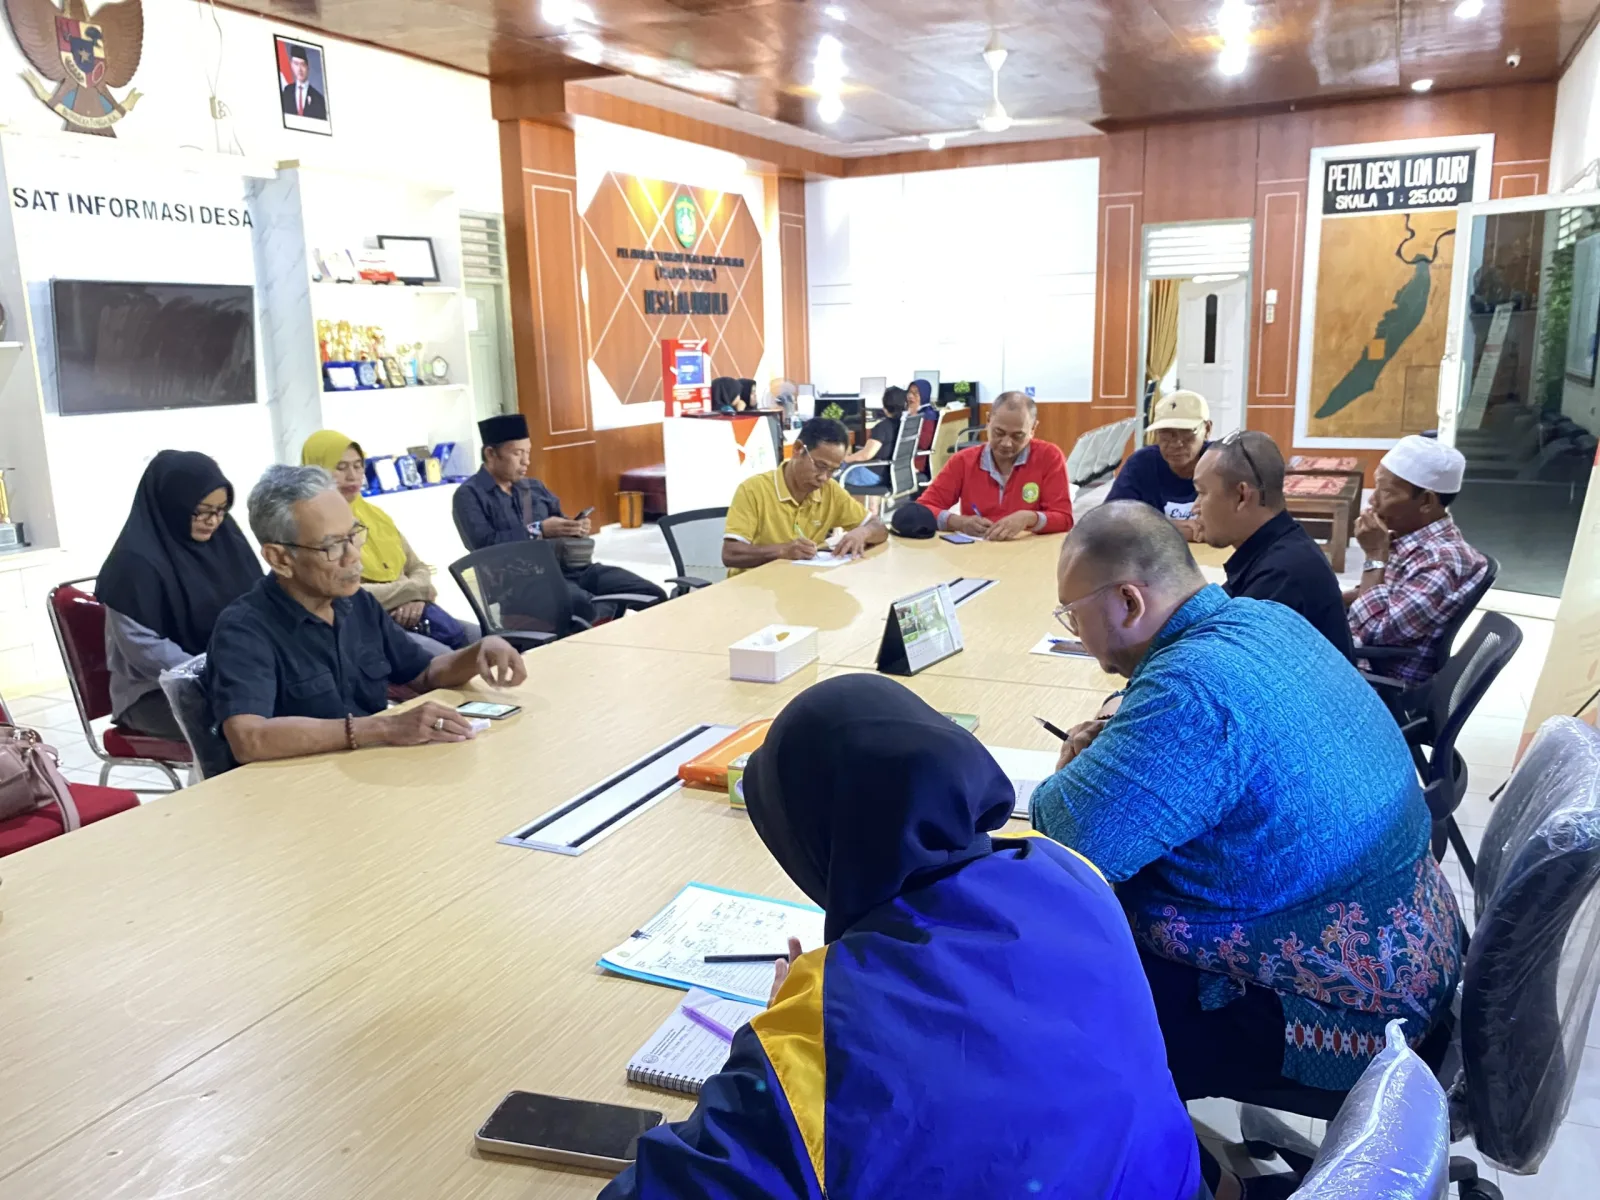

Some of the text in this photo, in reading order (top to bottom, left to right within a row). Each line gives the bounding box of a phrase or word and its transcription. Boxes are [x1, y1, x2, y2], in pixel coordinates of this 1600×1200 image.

[1328, 155, 1470, 192] PETA DESA LOA DURI
[12, 187, 254, 228] SAT INFORMASI DESA
[1335, 193, 1378, 210] SKALA
[1386, 191, 1394, 206] 1
[1408, 187, 1457, 206] 25.000
